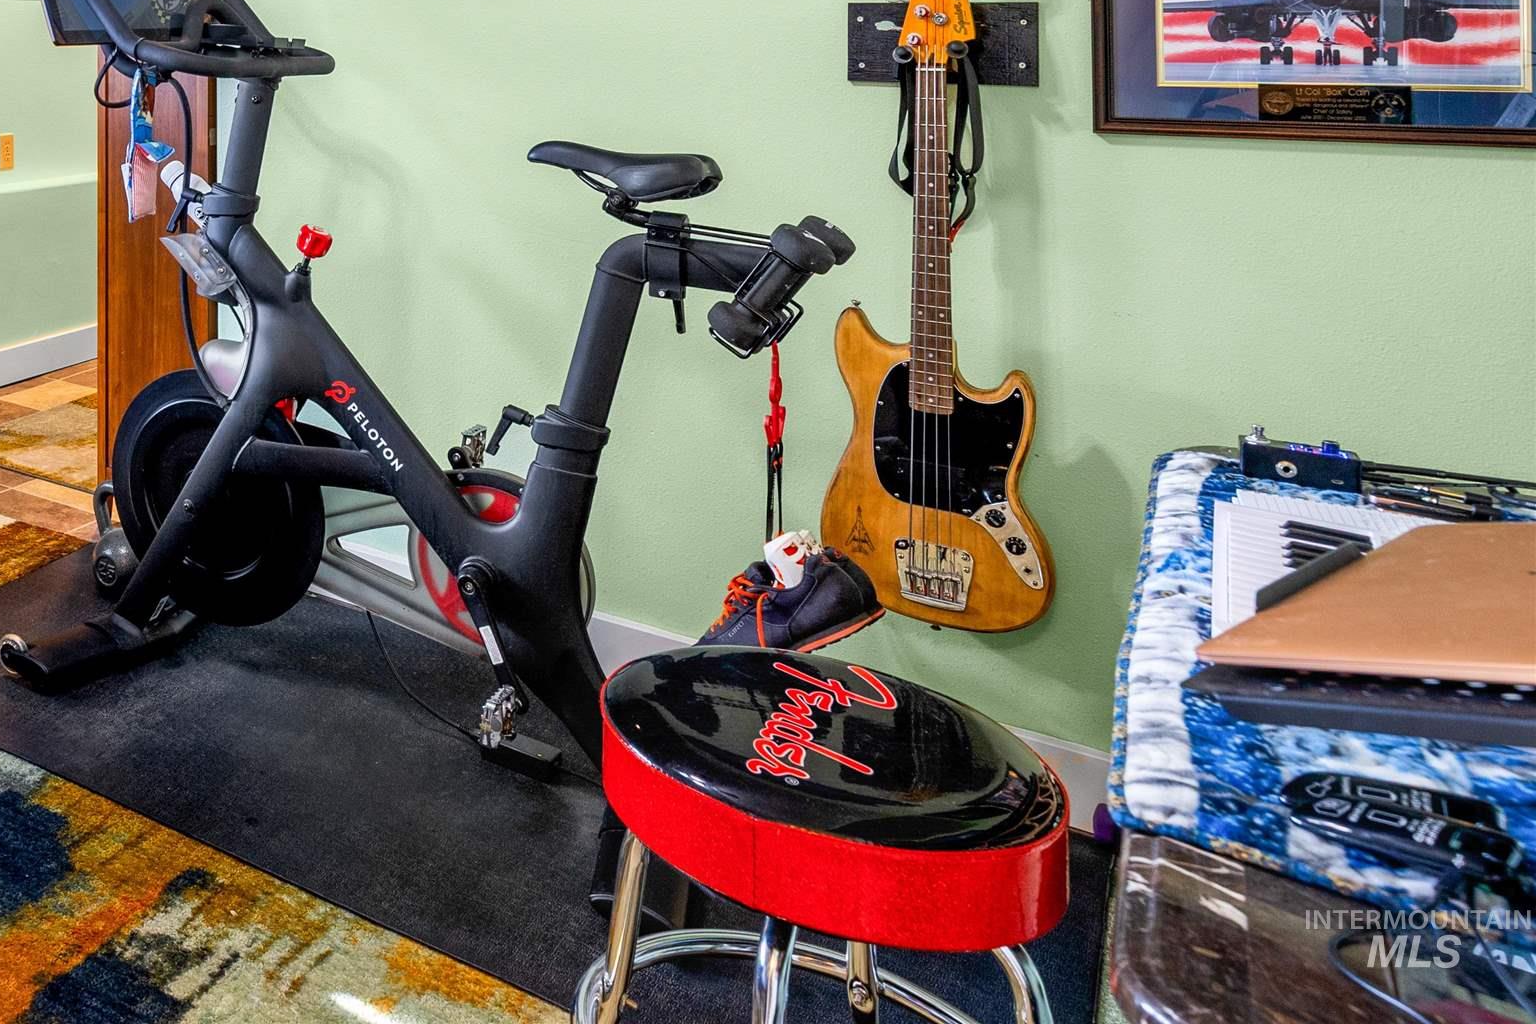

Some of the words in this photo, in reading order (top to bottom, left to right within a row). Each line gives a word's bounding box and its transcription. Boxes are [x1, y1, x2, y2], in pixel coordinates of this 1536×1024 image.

[1295, 87, 1303, 96] Lt
[1304, 87, 1321, 96] Col
[1348, 87, 1370, 96] Cain
[347, 402, 404, 472] PELOTON
[728, 619, 746, 638] GIRO
[745, 662, 898, 779] Fender
